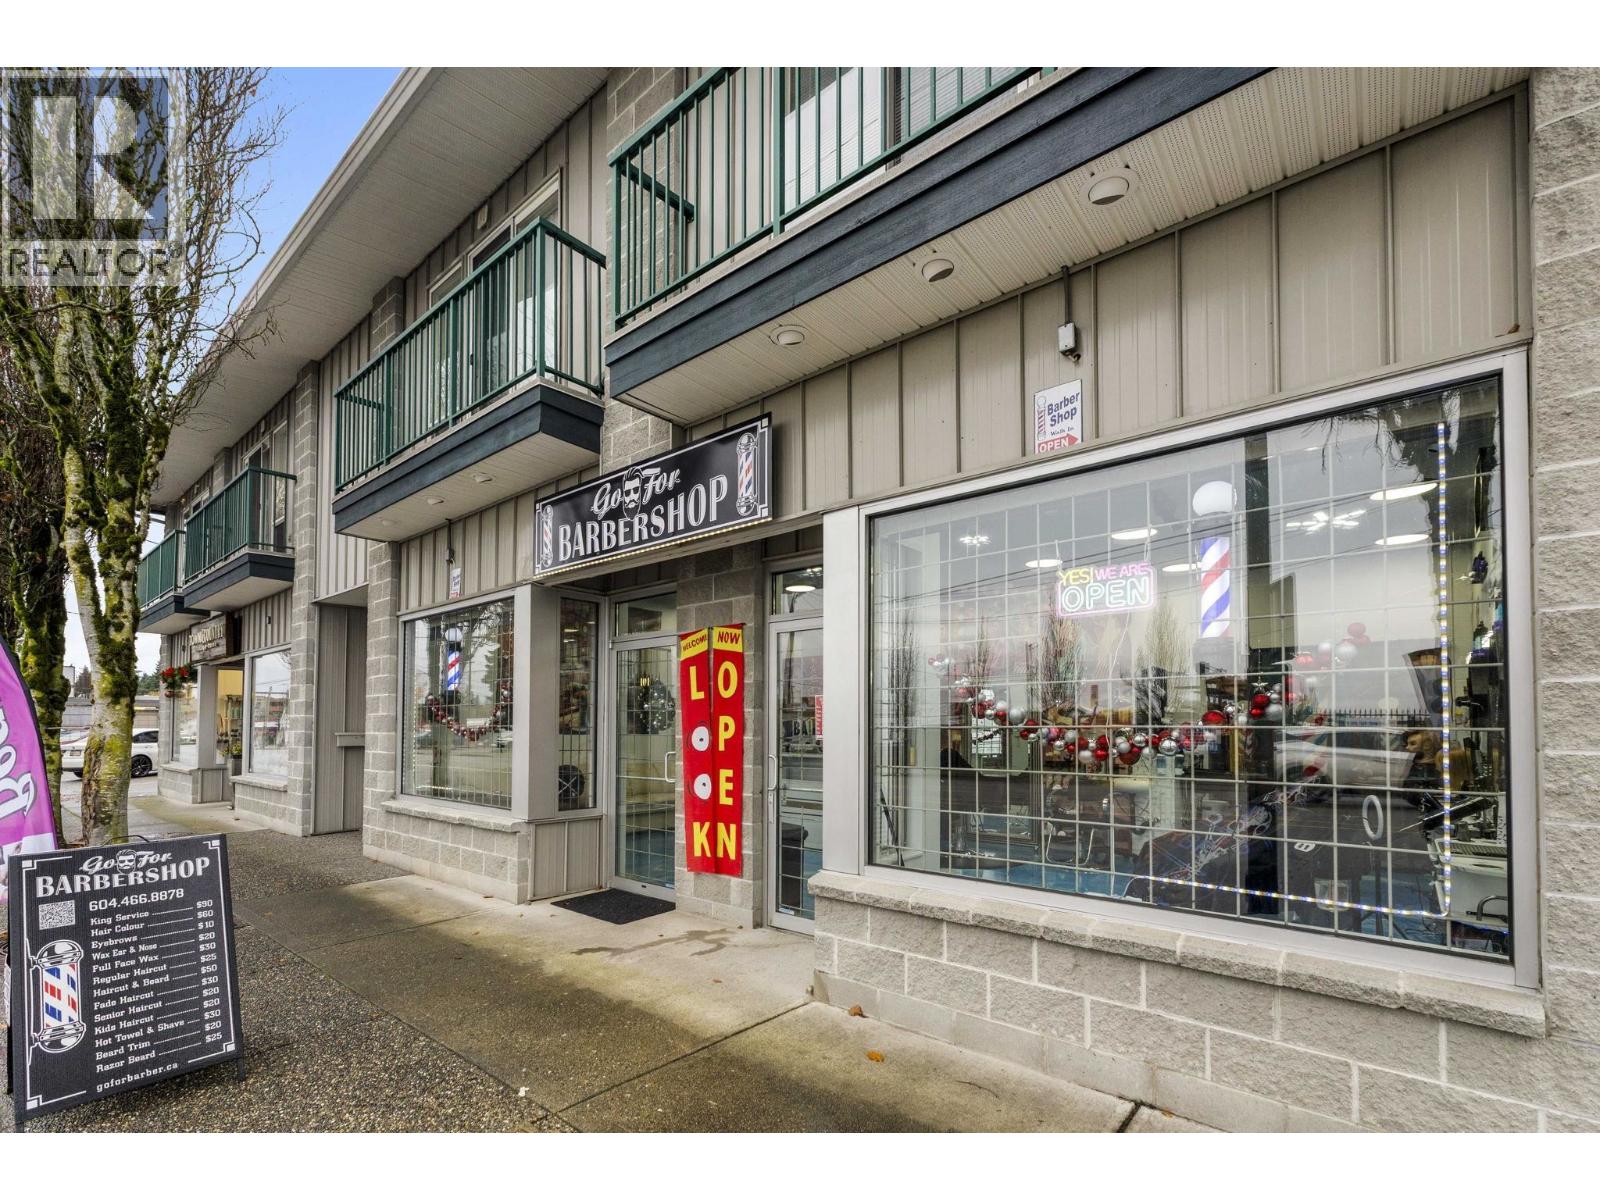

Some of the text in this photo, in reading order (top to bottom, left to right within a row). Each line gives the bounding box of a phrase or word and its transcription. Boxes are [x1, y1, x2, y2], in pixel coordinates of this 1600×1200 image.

[1047, 392, 1080, 416] Barber
[1050, 407, 1077, 427] Shop
[1040, 437, 1069, 452] OPEN
[591, 467, 681, 520] Go For
[558, 474, 728, 562] BARBERSHOP
[1095, 566, 1118, 581] WE
[1119, 562, 1149, 578] ARE
[1061, 576, 1149, 612] OPEN
[717, 631, 740, 645] NOW
[717, 660, 739, 860] OPEN
[36, 856, 210, 898] BARBERSHOP
[79, 851, 173, 875] Go For
[89, 888, 184, 911] 604.466.8878
[90, 899, 213, 926] King Service $90
[91, 909, 214, 937] Hair Colour $60
[91, 920, 215, 949] Eyebrows $10
[92, 932, 215, 961] Wax Ear & Nose $20
[92, 942, 216, 973] Full Face Wax $30
[93, 953, 217, 985] Regular Haircut $25
[93, 964, 218, 998] Haircut & Beard $50
[93, 975, 219, 1011] Fade Haircut $30
[94, 986, 220, 1023] Senior Haircut $20
[94, 998, 220, 1036] Kids Haircut $20
[95, 1009, 221, 1048] Hot Towel & Shave $30
[95, 1020, 222, 1061] Beard Trim $20
[95, 1032, 223, 1073] Razor Beard $25
[96, 1062, 179, 1093] goforbarber.ca
